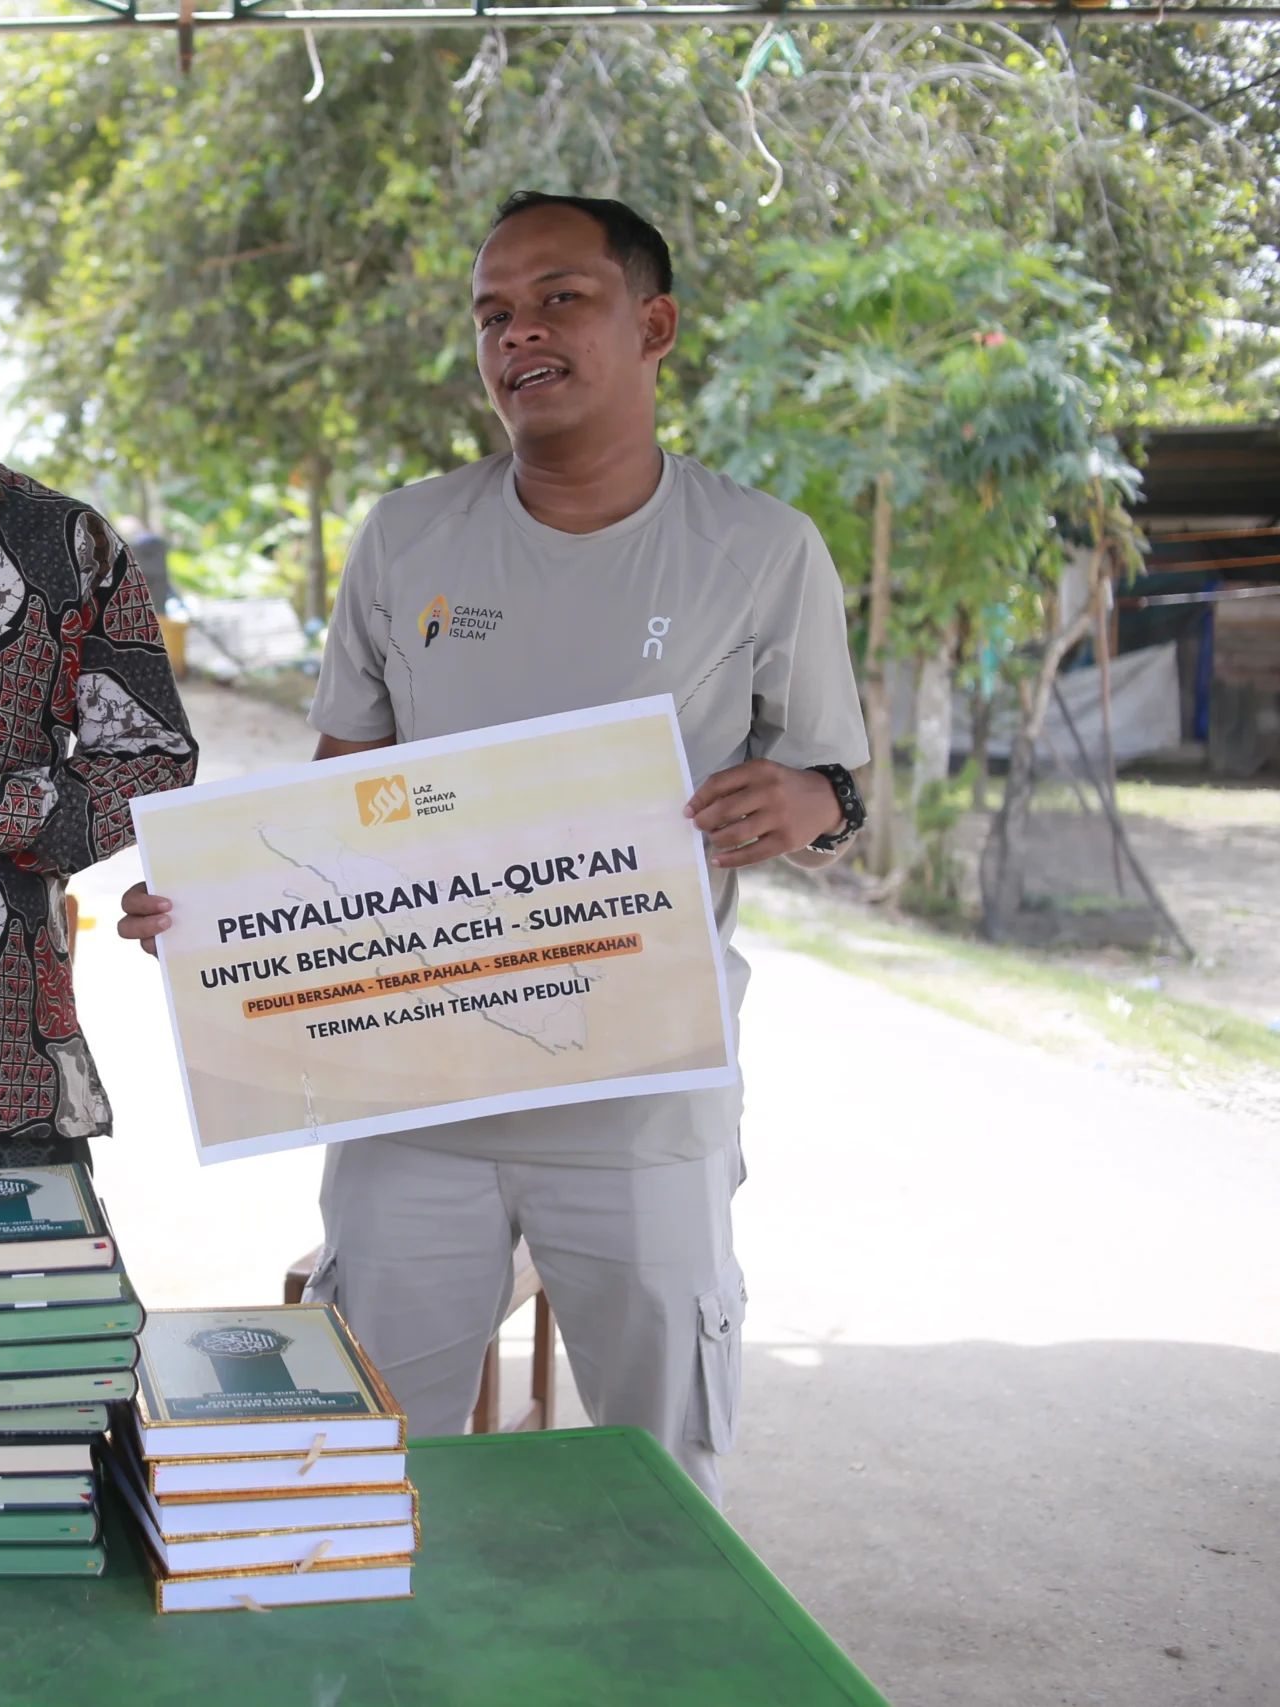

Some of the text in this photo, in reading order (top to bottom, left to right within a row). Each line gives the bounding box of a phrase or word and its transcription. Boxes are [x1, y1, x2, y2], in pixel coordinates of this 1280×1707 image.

[454, 605, 504, 620] CAHAYA
[451, 616, 497, 631] PEDULI
[449, 627, 487, 641] ISLAM
[412, 784, 433, 795] LAZ
[414, 791, 457, 806] CAHAYA
[416, 802, 455, 817] PEDULI
[217, 880, 439, 944] PENYALURAN
[200, 956, 292, 989] UNTUK
[296, 932, 427, 973] BENCANA
[432, 917, 504, 948] ACEH
[529, 890, 673, 930] SUMATERA
[247, 998, 295, 1013] PEDULI
[296, 983, 366, 1005] BERSAMA
[375, 972, 422, 990] TEBAR
[423, 962, 482, 982] PAHALA
[493, 951, 540, 969] SEBAR
[541, 936, 637, 961] KEBERKAHAN
[305, 977, 590, 1039] TERIMA KASIH TEMAN PEDULI
